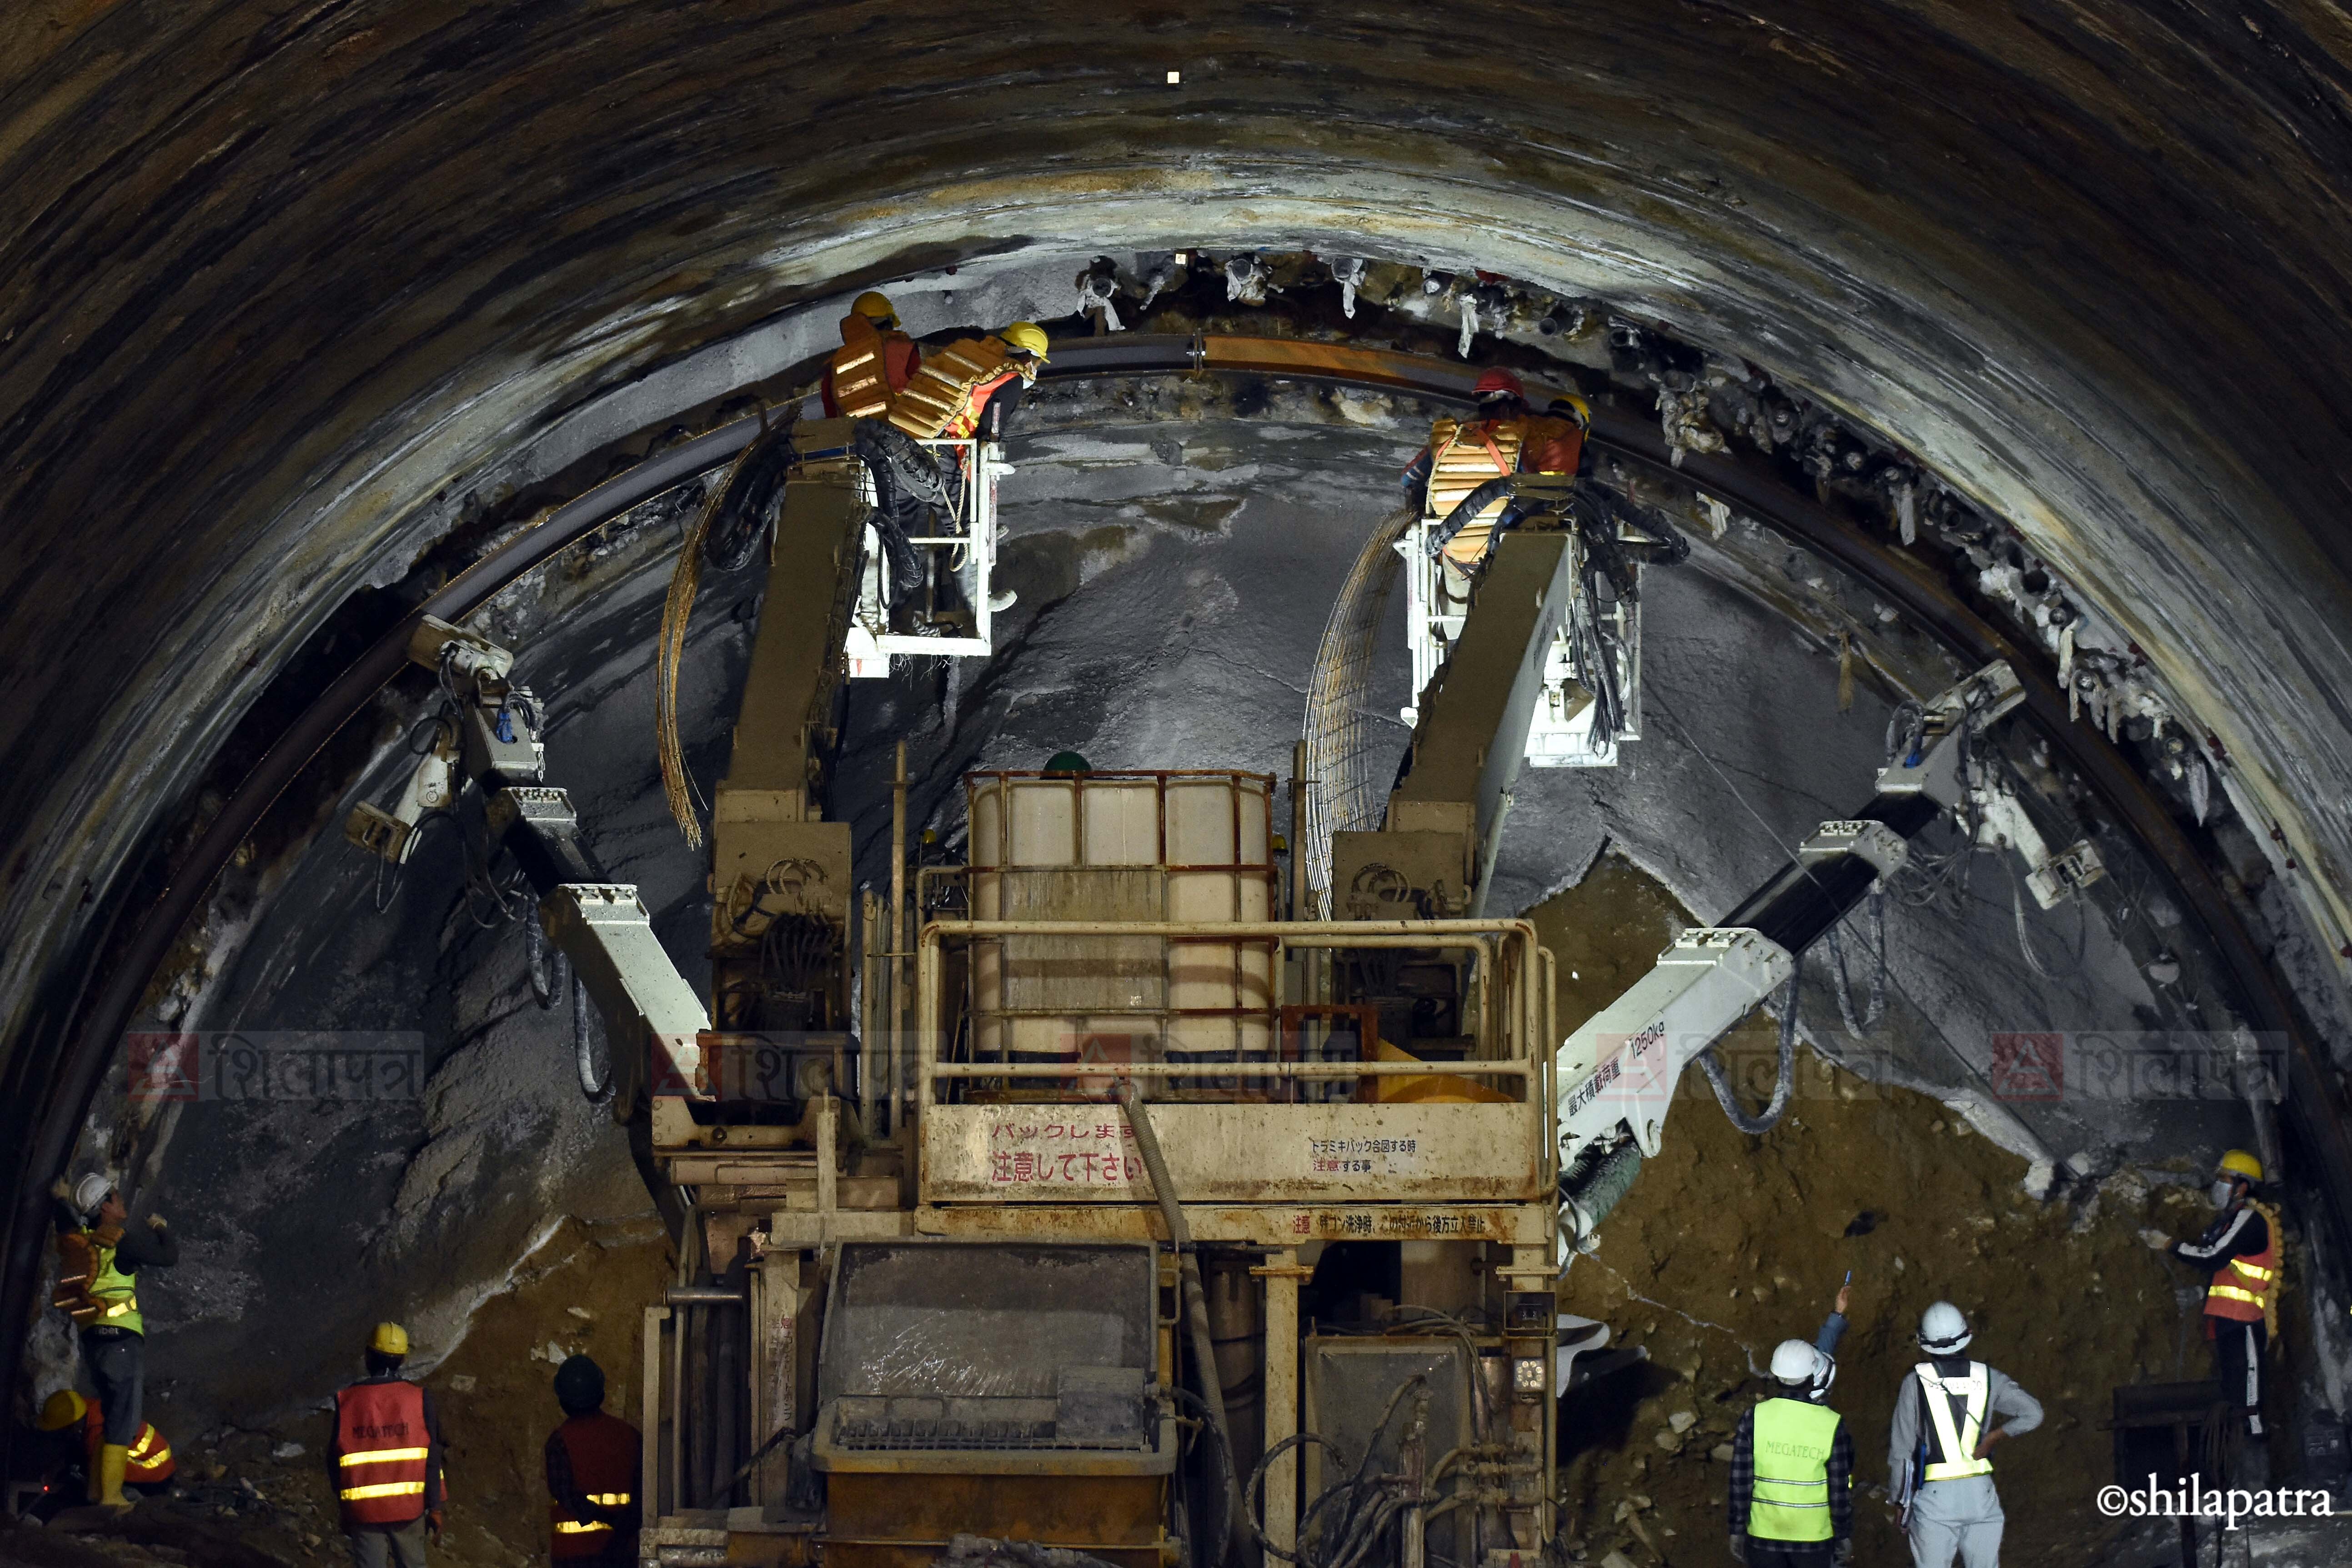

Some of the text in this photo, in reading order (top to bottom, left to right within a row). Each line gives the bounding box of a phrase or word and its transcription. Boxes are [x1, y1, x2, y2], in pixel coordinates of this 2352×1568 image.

[1566, 1021, 1664, 1117] 最大積載荷重 1250kg
[992, 1150, 1143, 1182] 注意して下さい
[1313, 1159, 1371, 1172] 注意する事
[1293, 1214, 1310, 1234] 注意
[352, 1422, 408, 1438] MEGATECH
[1765, 1440, 1825, 1460] MEGATECH
